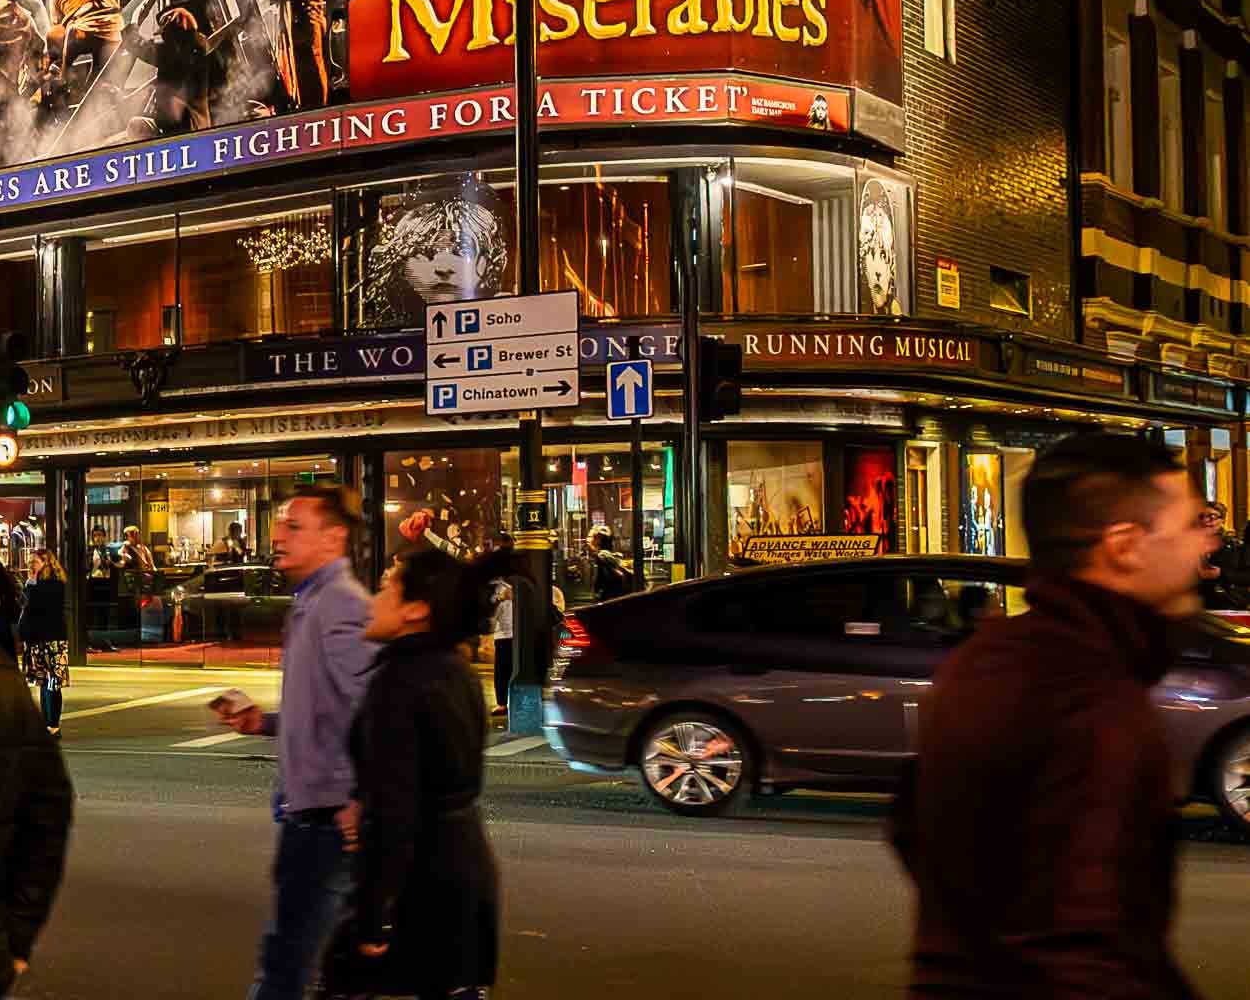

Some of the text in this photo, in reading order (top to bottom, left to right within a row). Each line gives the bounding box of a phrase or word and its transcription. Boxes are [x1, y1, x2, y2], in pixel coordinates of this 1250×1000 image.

[32, 161, 92, 196] ARE
[104, 142, 198, 184] STILL
[213, 108, 407, 165] FIGHTING
[428, 93, 516, 132] FOR
[537, 96, 559, 119] A
[458, 310, 522, 334] P Soho
[471, 344, 574, 370] P Brewer St
[744, 334, 885, 357] RUNNING
[894, 335, 973, 362] MUSICAL
[269, 350, 340, 375] THE
[436, 384, 539, 408] P Chinatown
[750, 539, 871, 550] ADVANCE WARNING
